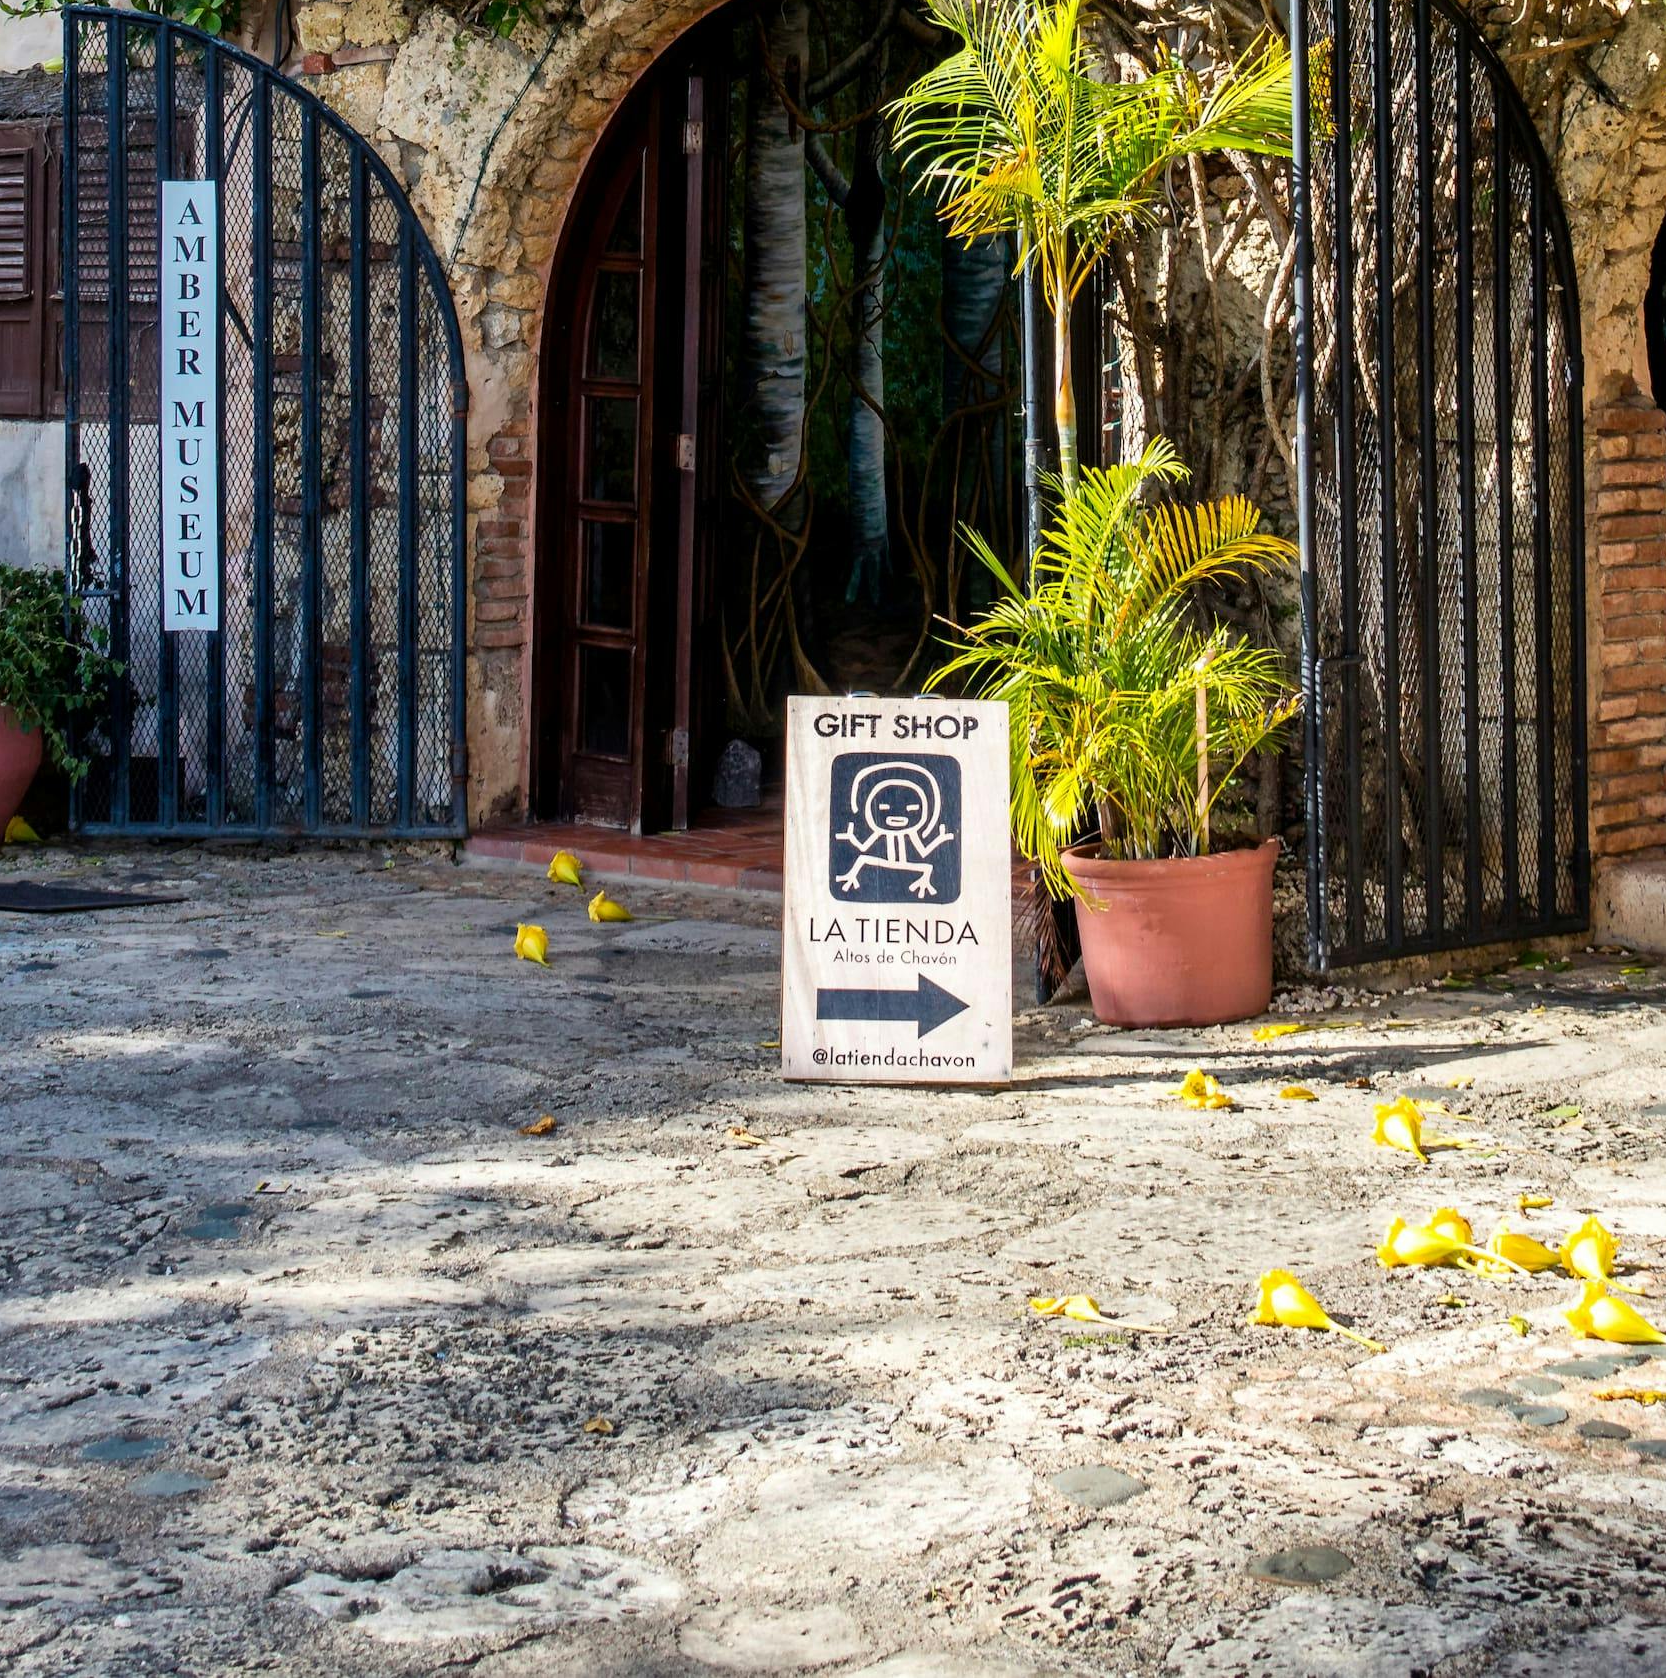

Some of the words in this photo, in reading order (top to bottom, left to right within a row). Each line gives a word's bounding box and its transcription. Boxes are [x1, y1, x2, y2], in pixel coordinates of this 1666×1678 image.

[172, 197, 208, 375] AMBER
[171, 401, 209, 616] MUSEUM
[813, 713, 882, 738] GIFT
[892, 714, 980, 739] SHOP
[809, 917, 846, 943] LA
[854, 918, 980, 946] TIENDA
[833, 949, 870, 964] Altos
[876, 949, 895, 965] de
[900, 950, 958, 966] Chavón
[812, 1046, 976, 1068] @latiendachavon
